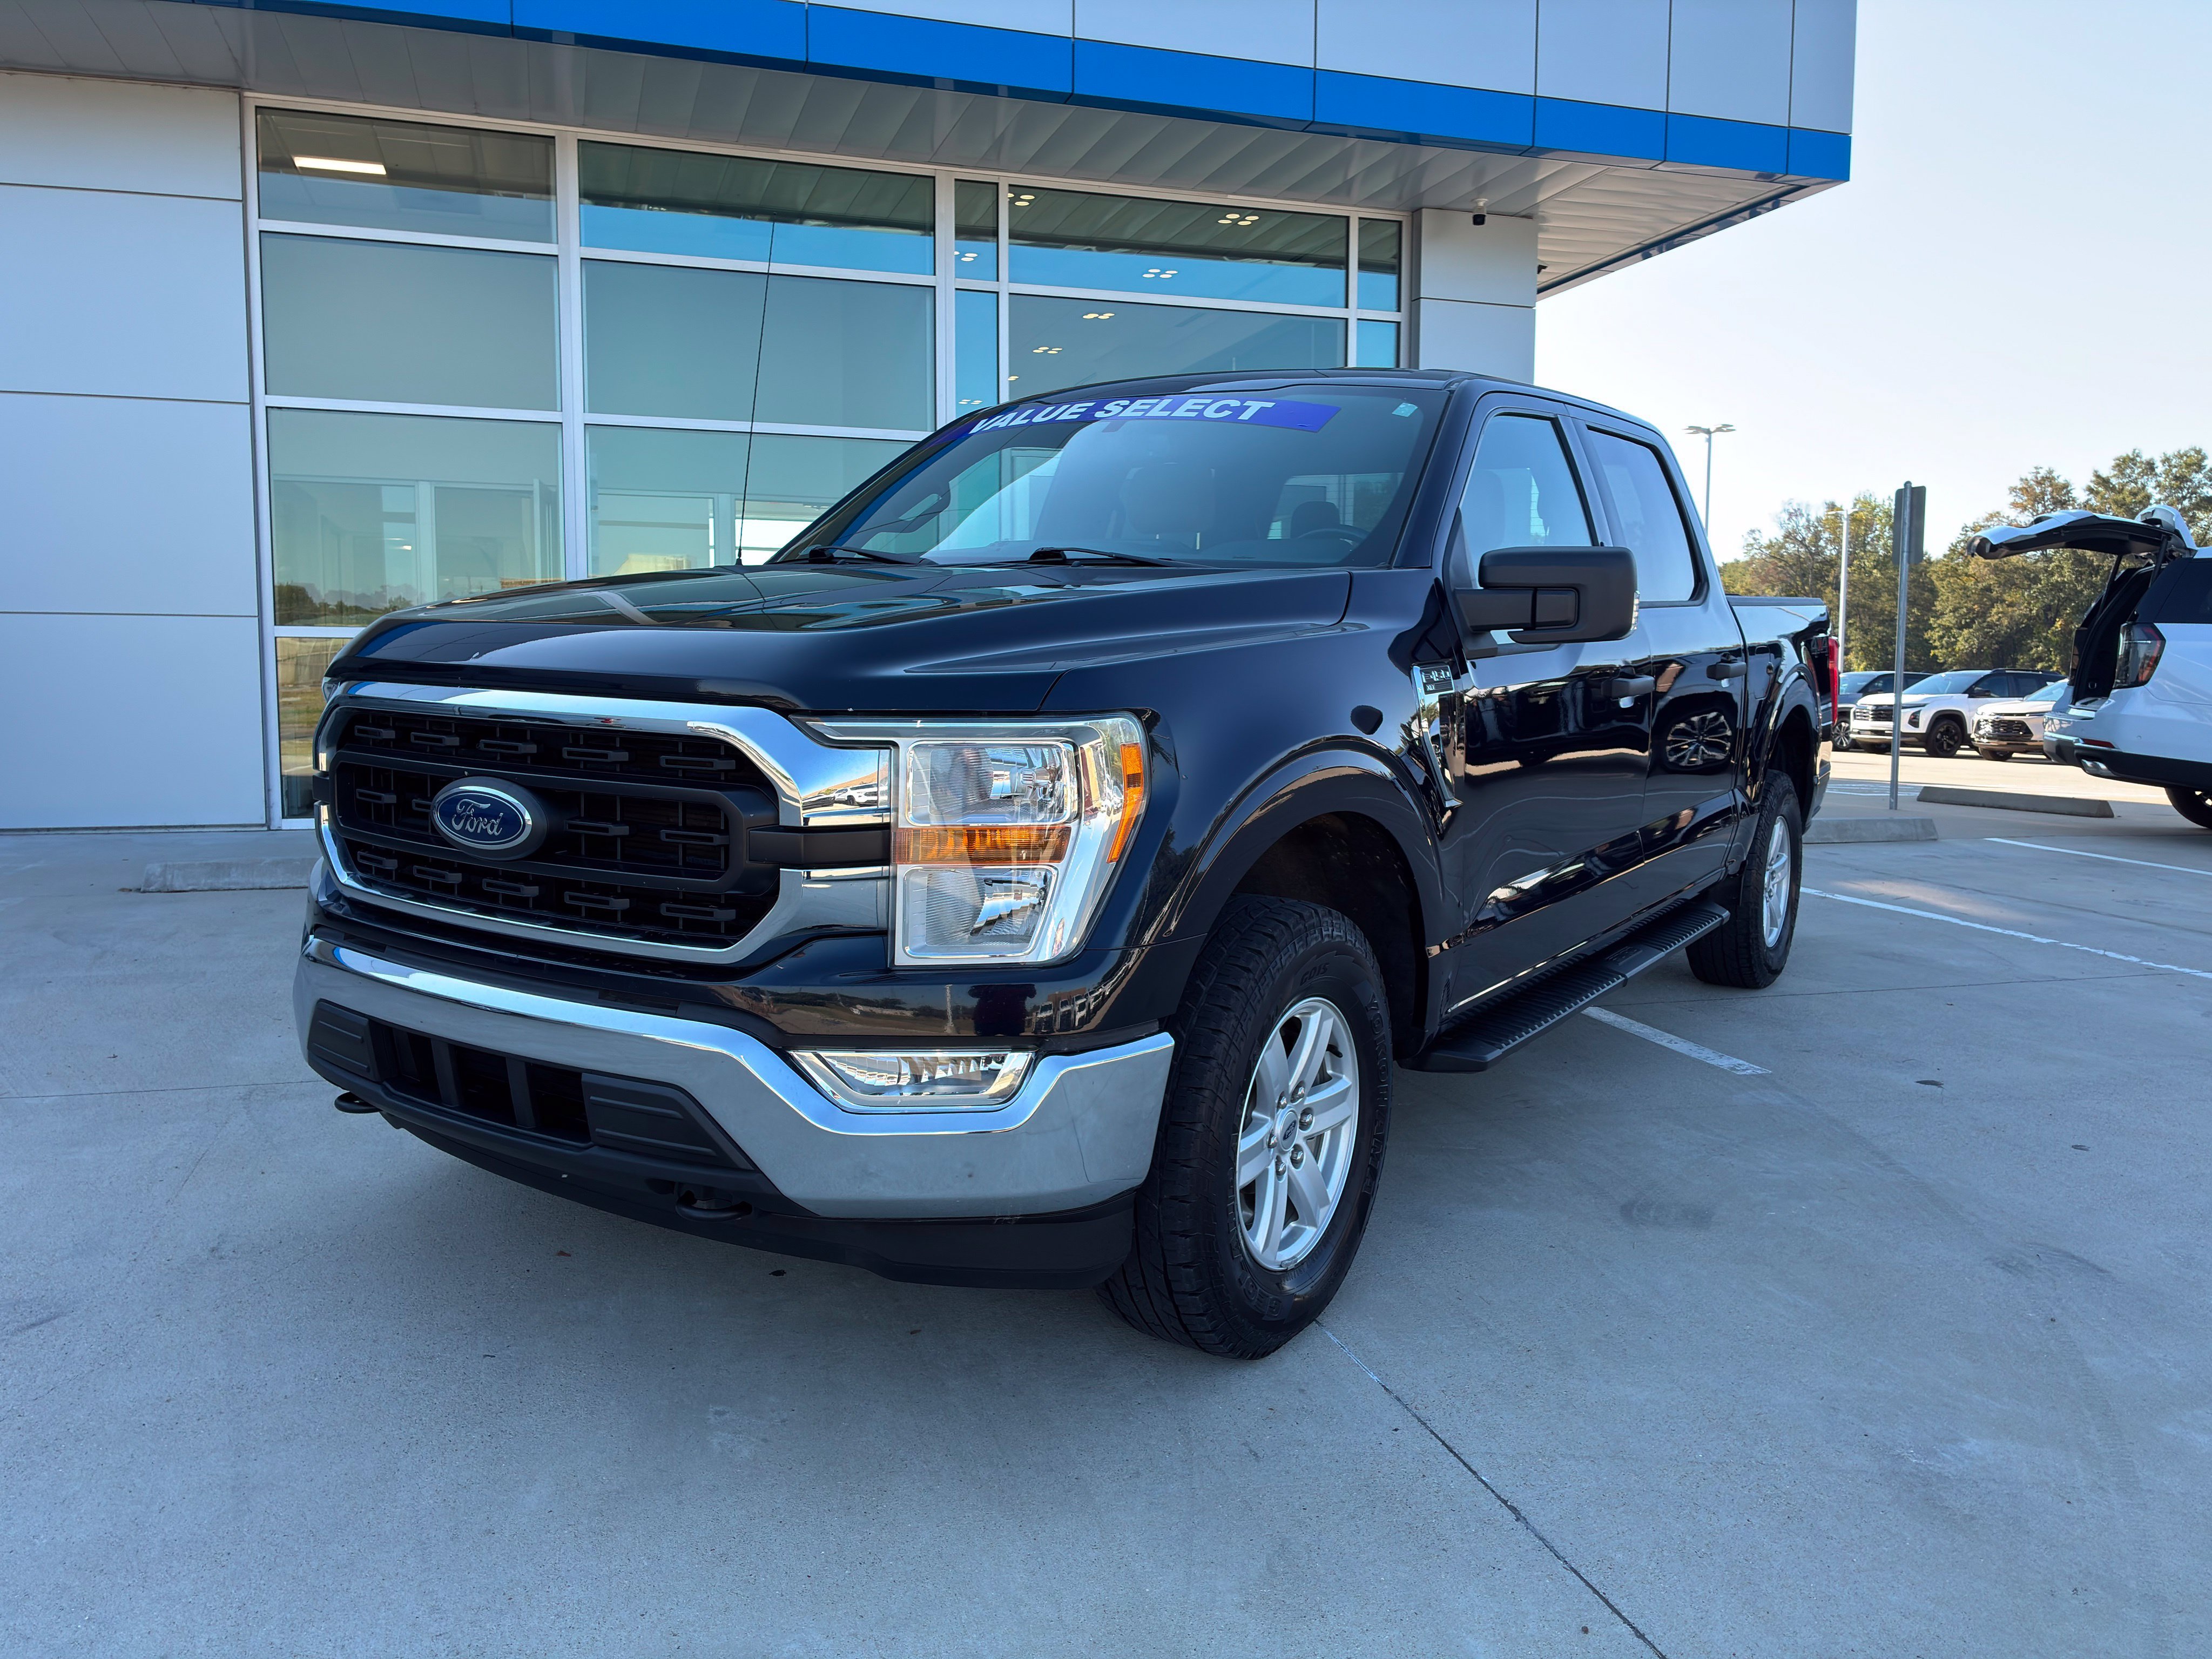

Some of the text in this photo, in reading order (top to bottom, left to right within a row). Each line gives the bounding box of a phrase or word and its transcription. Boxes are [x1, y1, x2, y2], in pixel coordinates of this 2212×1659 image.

[968, 399, 1276, 434] VALUE SELECT
[451, 799, 503, 836] Ford
[1361, 992, 1389, 1195] YOKOHAMA
